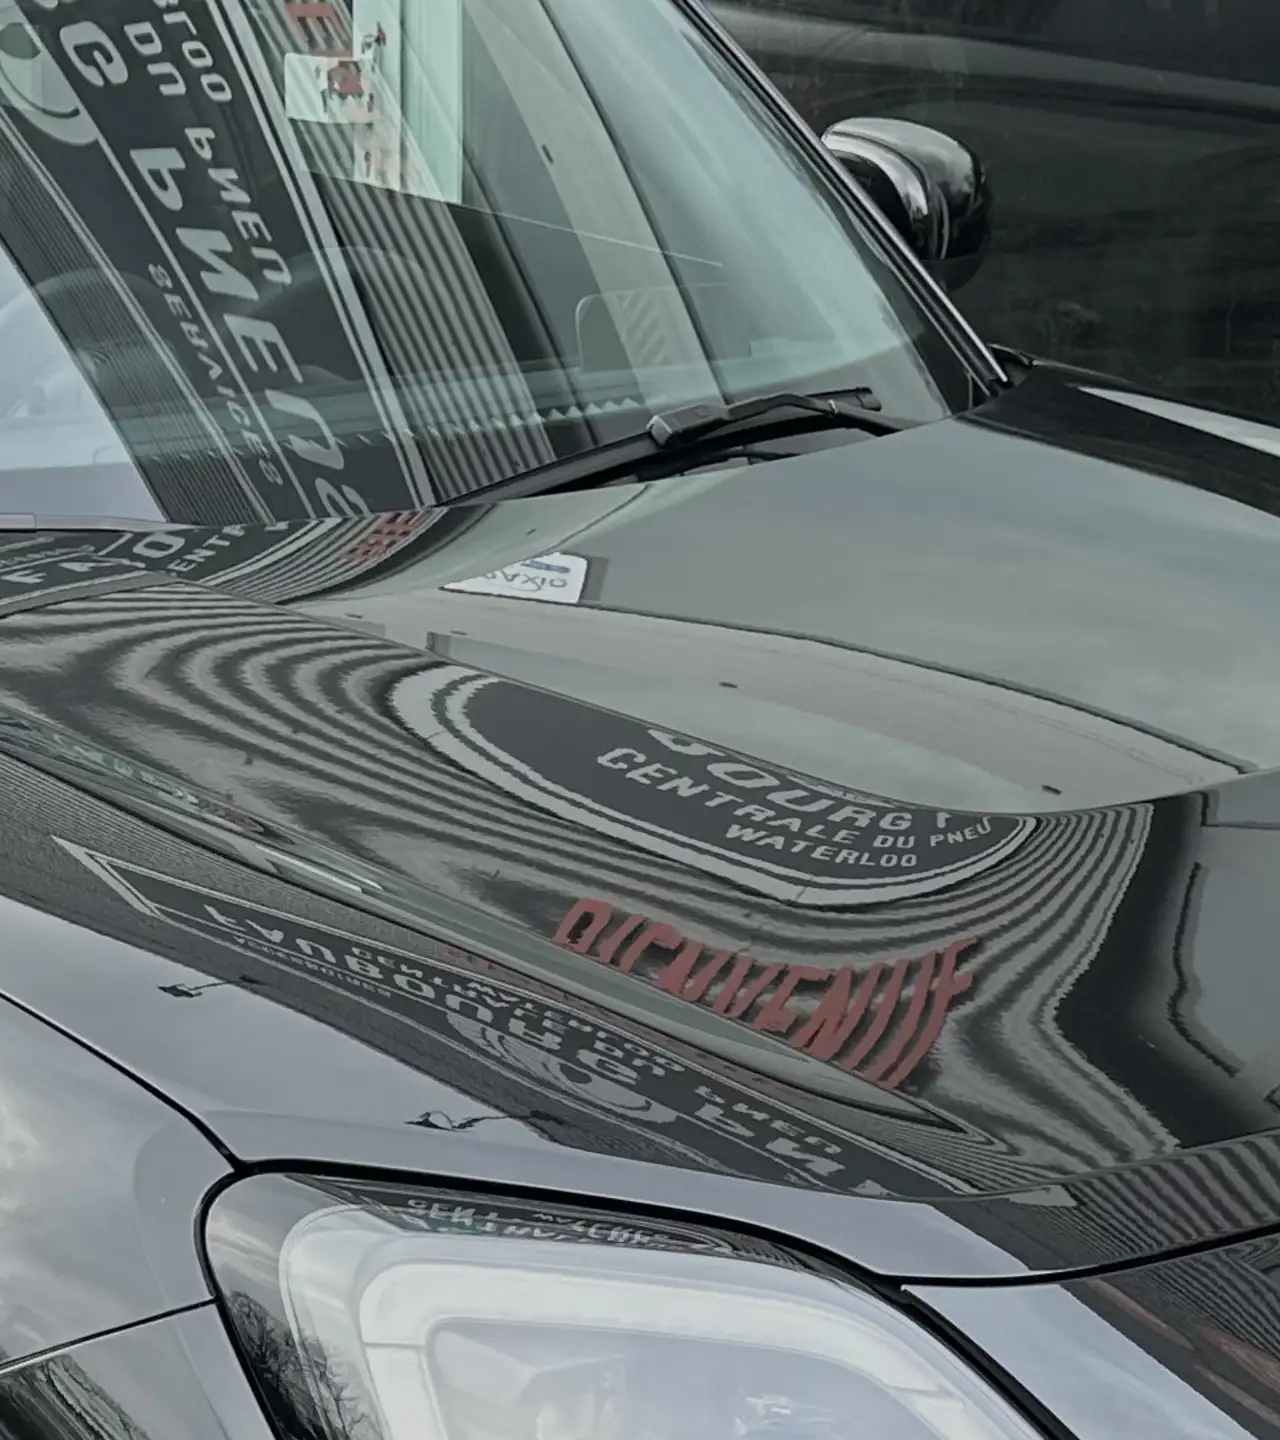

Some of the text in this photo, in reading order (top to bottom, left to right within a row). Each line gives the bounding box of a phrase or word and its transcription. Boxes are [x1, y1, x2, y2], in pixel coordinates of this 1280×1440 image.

[596, 747, 861, 845] CENTRALE
[872, 834, 916, 849] DU
[929, 815, 1004, 848] PNEU
[725, 824, 918, 868] WATERLOO
